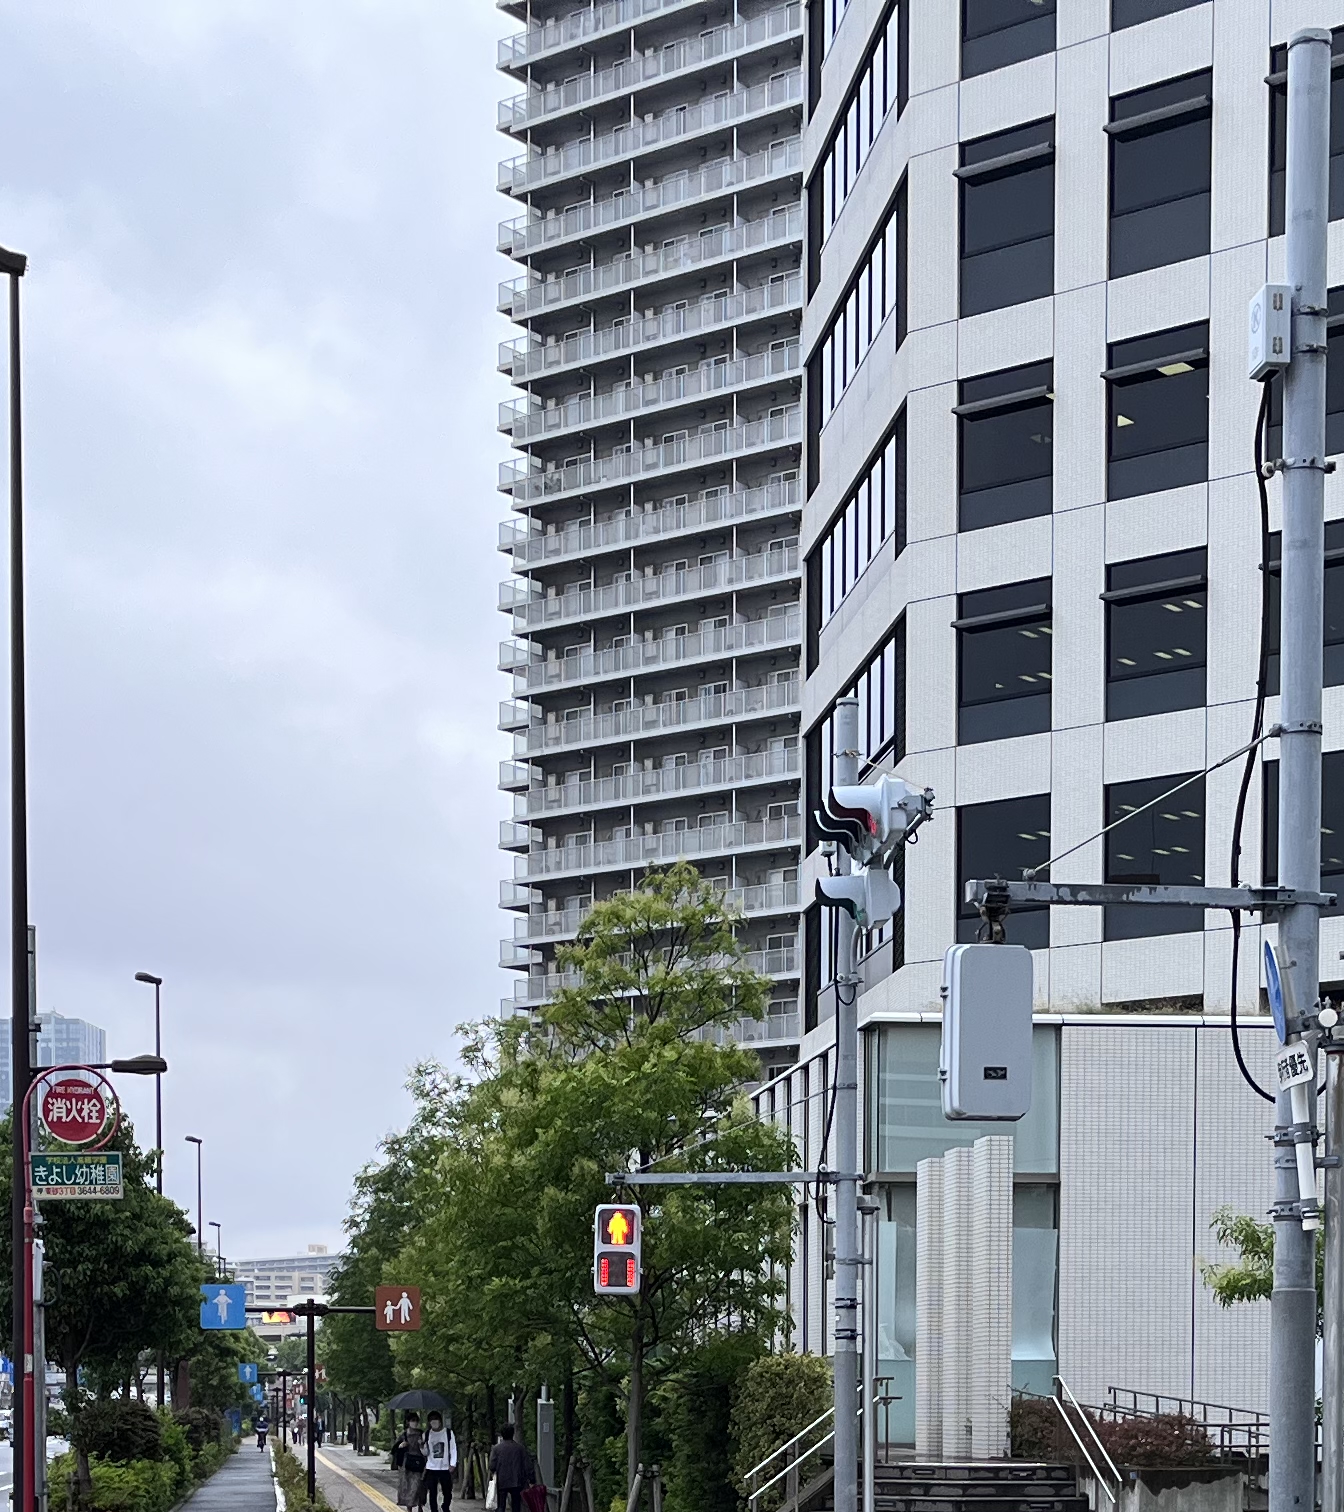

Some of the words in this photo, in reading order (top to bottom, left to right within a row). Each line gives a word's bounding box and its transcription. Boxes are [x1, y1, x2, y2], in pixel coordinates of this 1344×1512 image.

[47, 1097, 101, 1123] 消火栓
[34, 1164, 119, 1185] きよし幼稚園
[77, 1186, 120, 1196] 3644-6809
